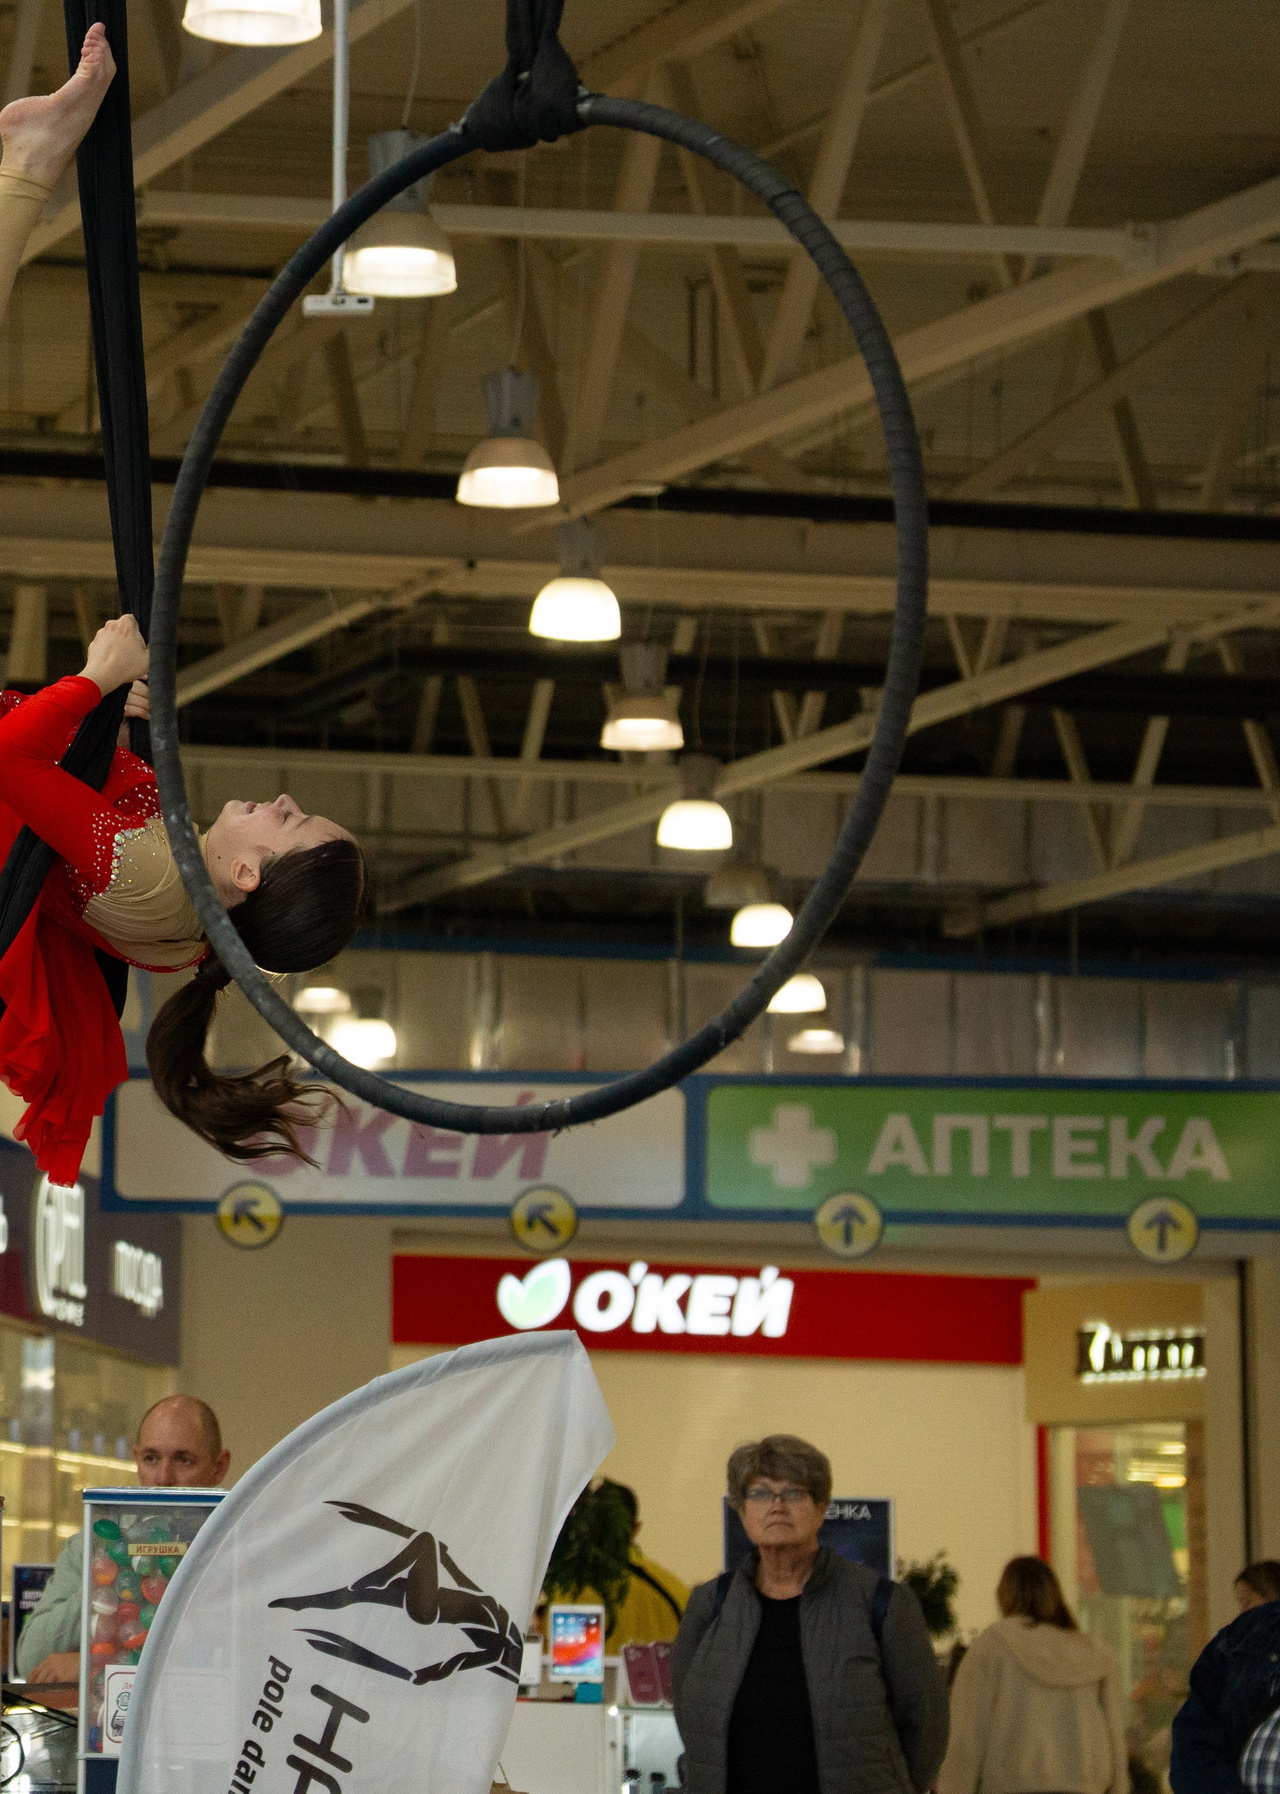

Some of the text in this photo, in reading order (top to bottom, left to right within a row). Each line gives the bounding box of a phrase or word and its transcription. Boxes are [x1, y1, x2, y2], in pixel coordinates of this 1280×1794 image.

[867, 1113, 1231, 1181] АПТЕКА
[136, 1545, 180, 1554] ИГРУШКА
[251, 1655, 293, 1733] pole
